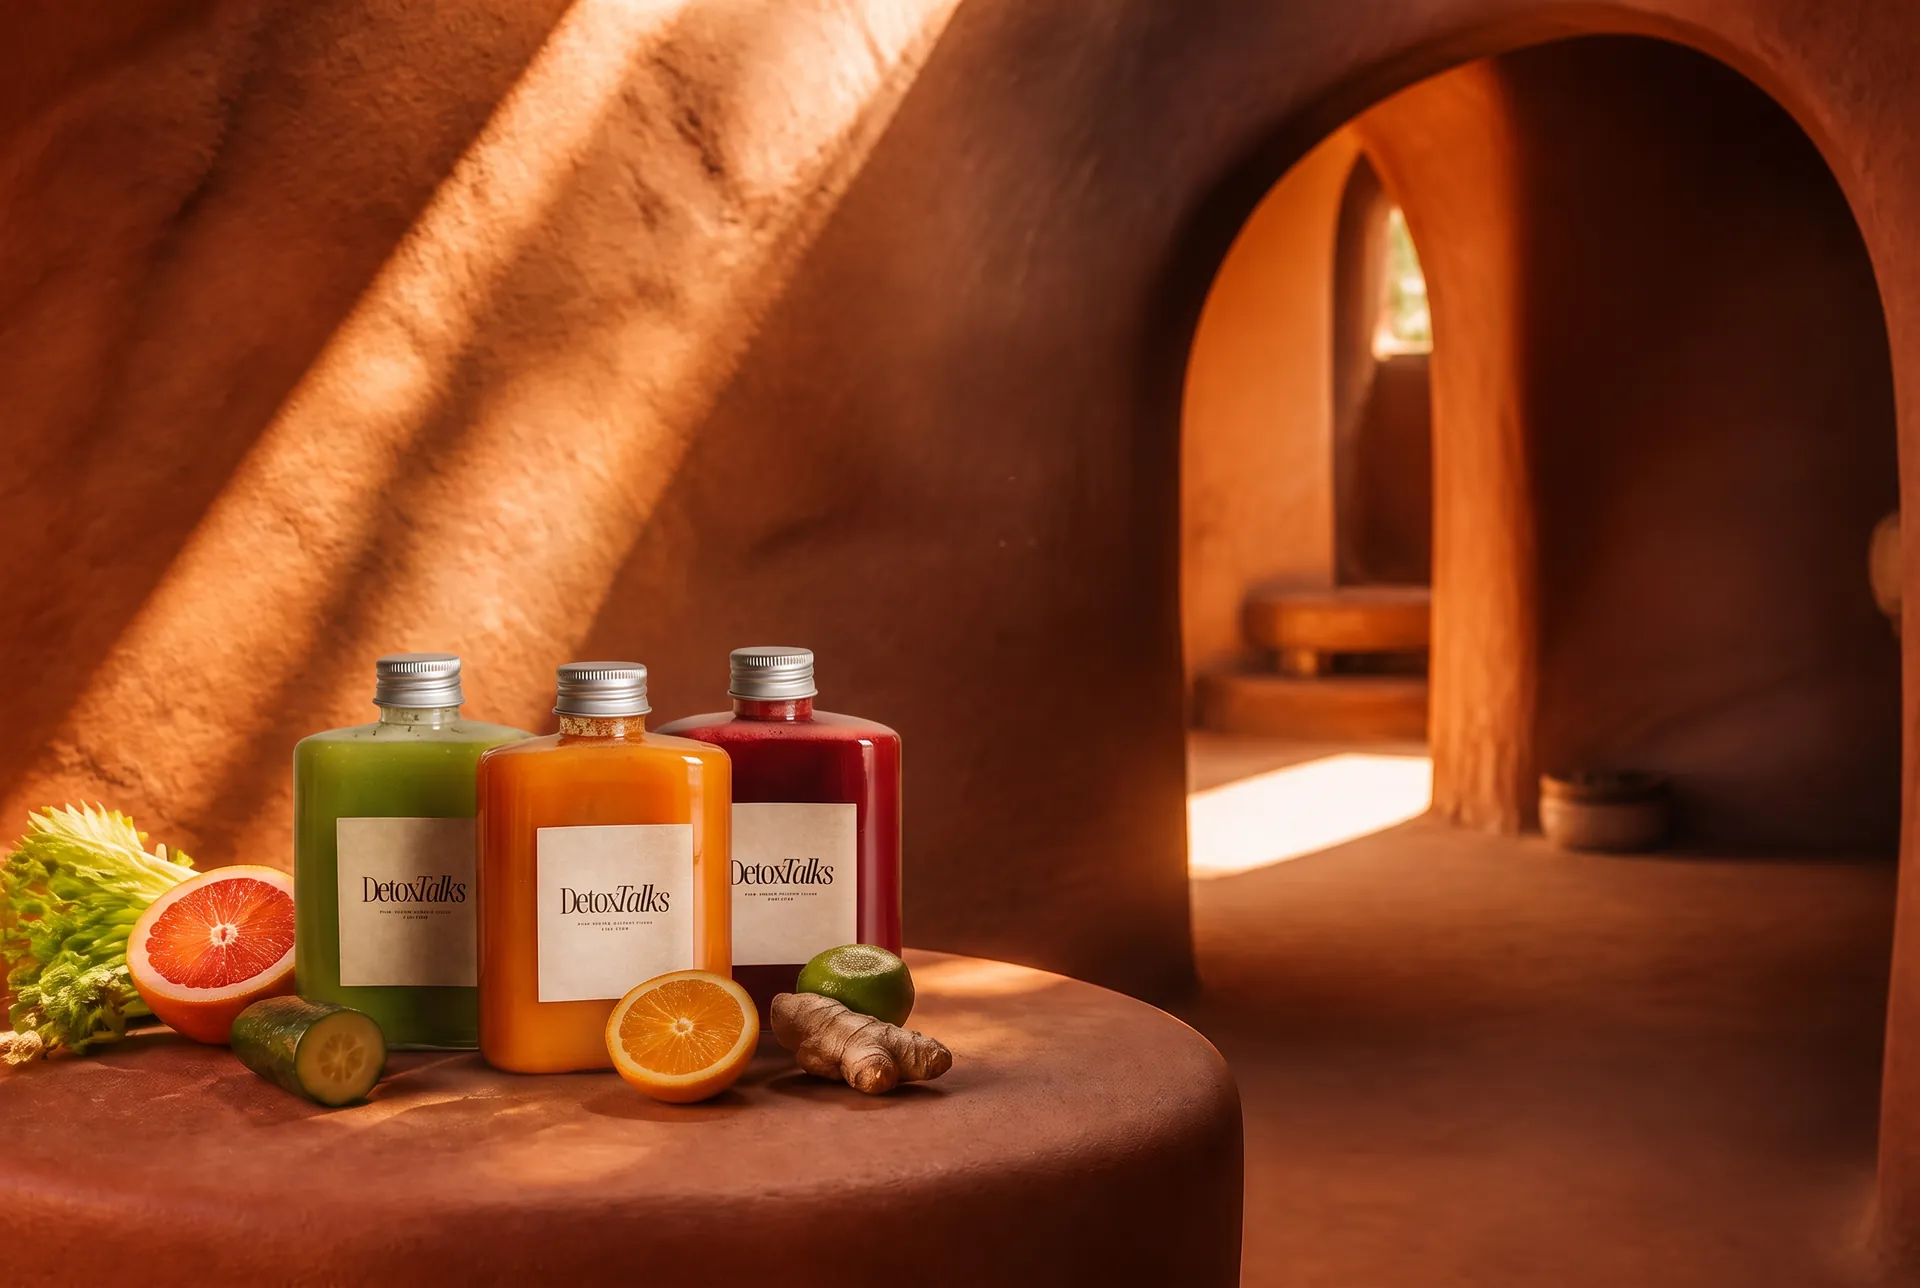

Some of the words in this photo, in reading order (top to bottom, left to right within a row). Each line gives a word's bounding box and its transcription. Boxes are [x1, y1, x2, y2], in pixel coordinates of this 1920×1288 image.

[731, 857, 834, 886] DetoxTalks
[362, 875, 467, 903] DetoxTalks
[559, 884, 670, 914] DetoxTalks
